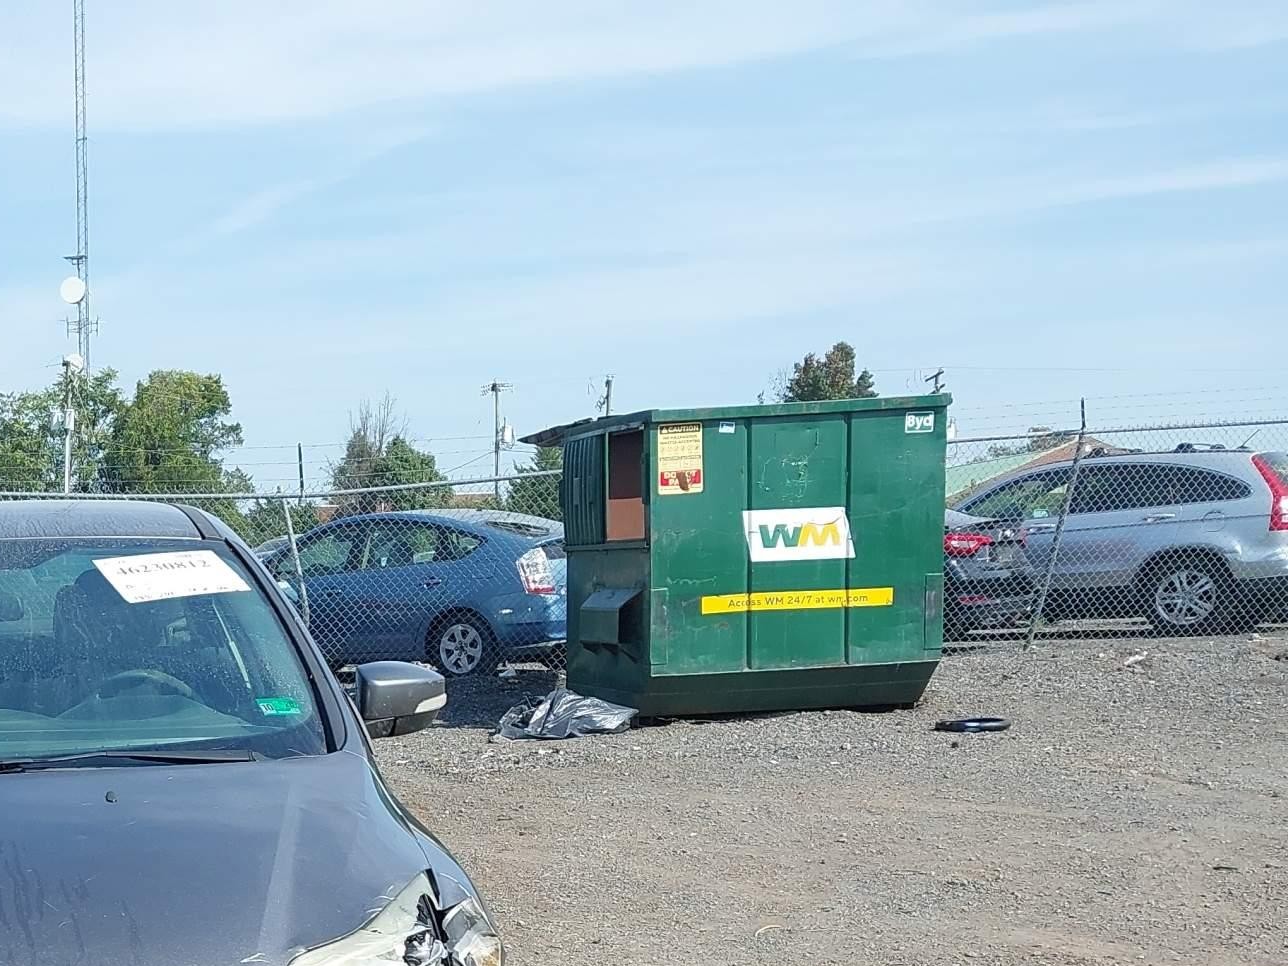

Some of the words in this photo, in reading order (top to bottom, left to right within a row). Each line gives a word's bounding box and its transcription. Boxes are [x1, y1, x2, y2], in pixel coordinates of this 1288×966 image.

[668, 425, 699, 433] CAUTION
[758, 522, 842, 548] WM
[765, 596, 785, 605] WM
[787, 595, 812, 605] 24/7
[815, 595, 826, 604] at
